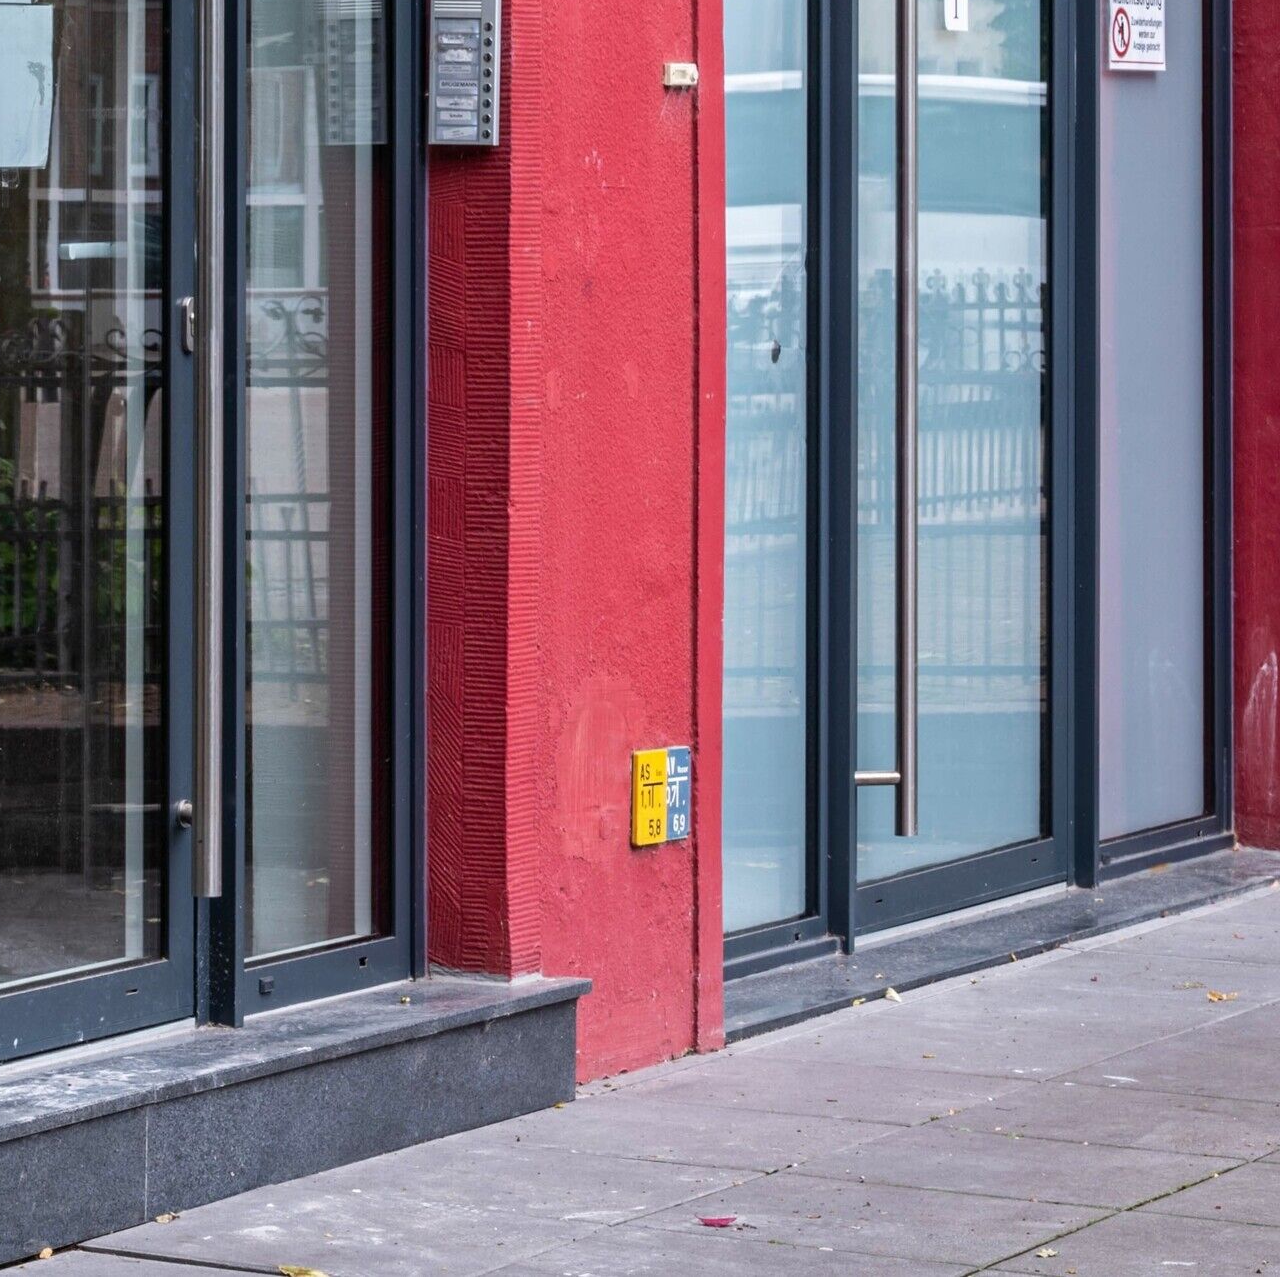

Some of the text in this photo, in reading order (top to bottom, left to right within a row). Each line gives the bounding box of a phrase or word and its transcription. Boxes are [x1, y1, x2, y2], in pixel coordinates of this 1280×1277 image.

[640, 764, 650, 781] AS
[649, 819, 661, 838] 5,8
[673, 813, 686, 835] 6,9
